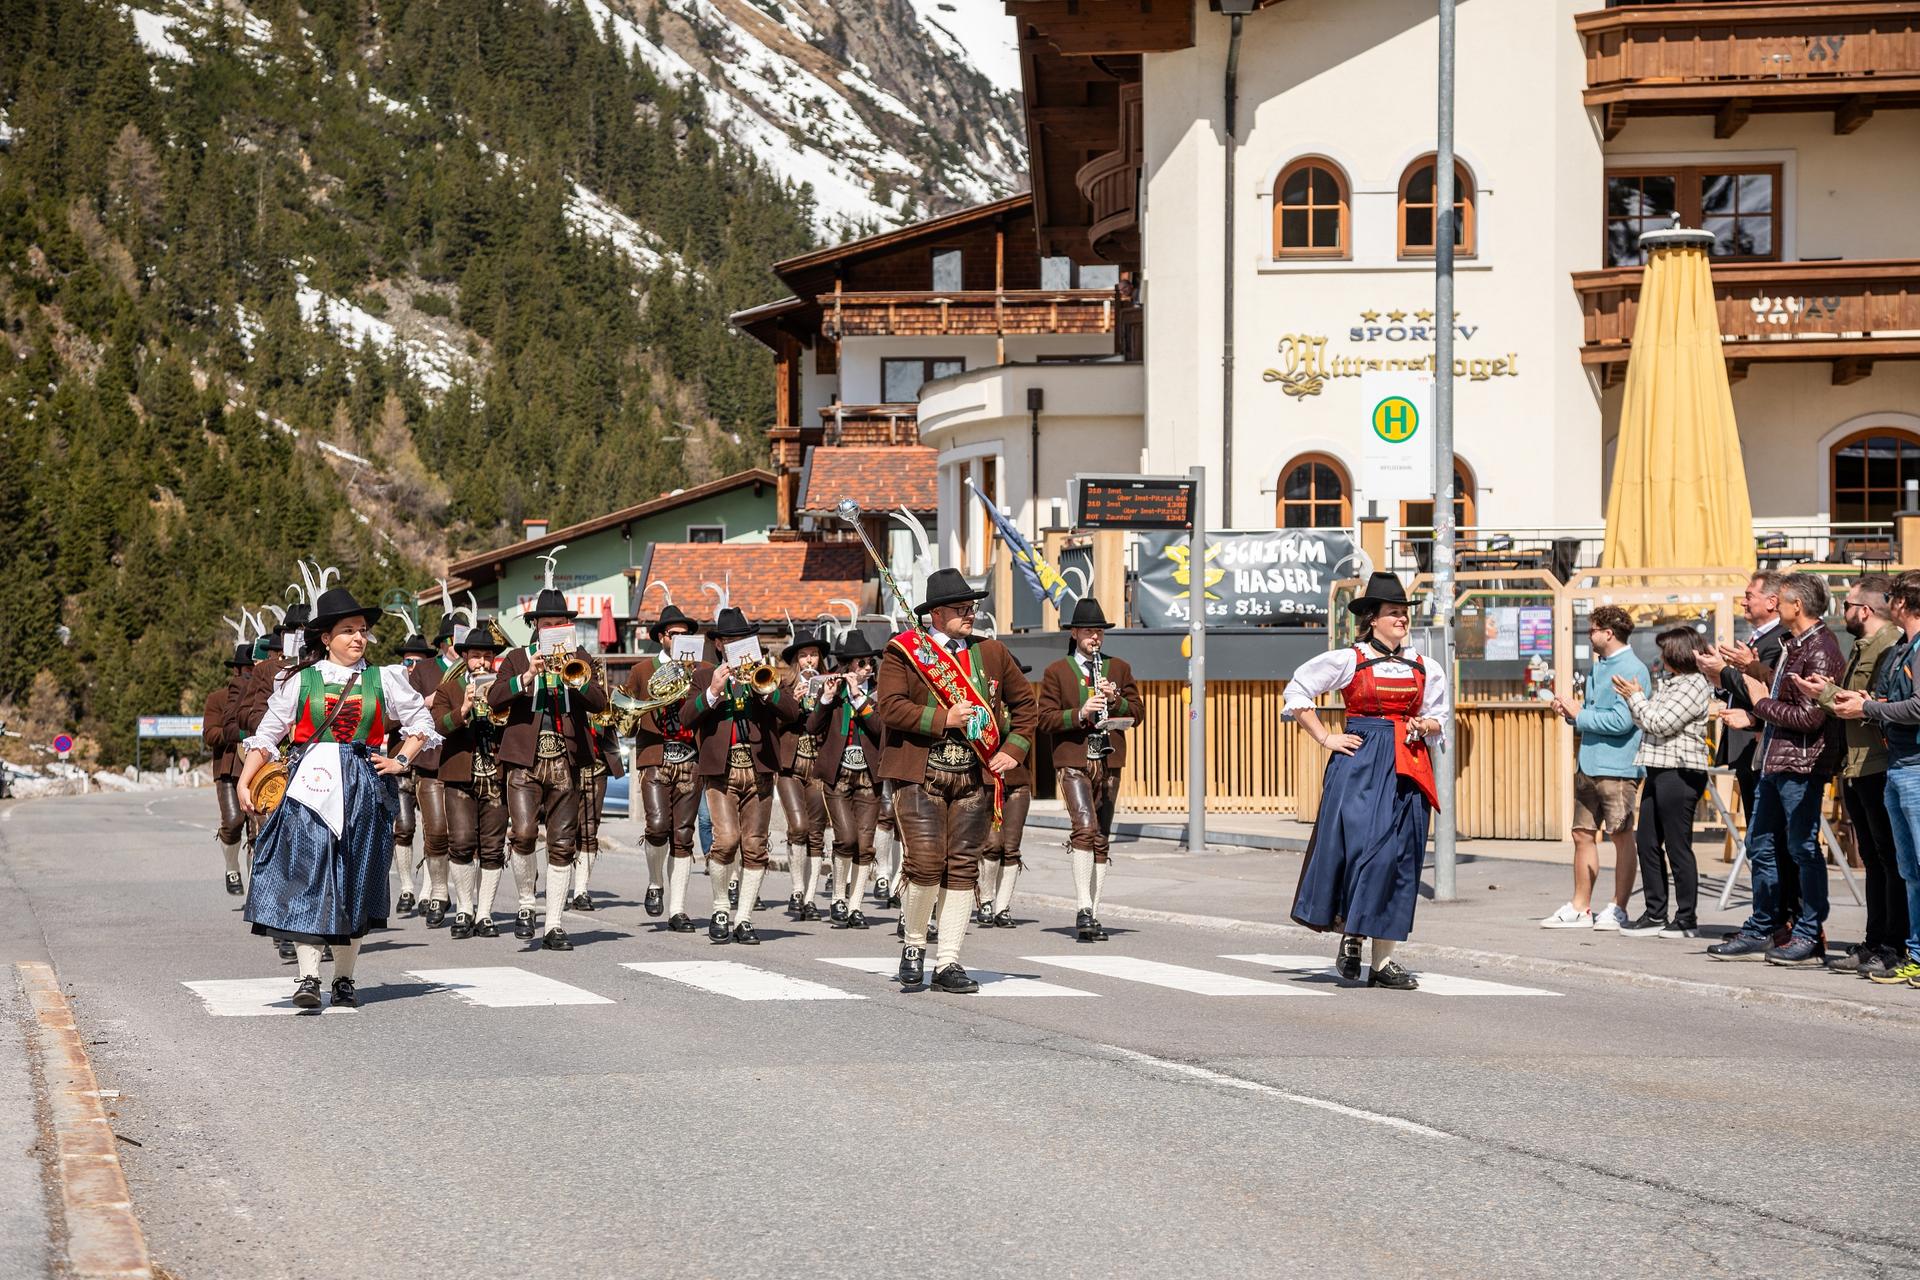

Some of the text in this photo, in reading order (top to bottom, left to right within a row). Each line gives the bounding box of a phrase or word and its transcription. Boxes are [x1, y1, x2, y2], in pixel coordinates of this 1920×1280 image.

[1350, 326, 1478, 342] SPORV
[1384, 405, 1407, 434] H
[1223, 539, 1327, 564] SCHIRM
[1234, 598, 1272, 616] Ski
